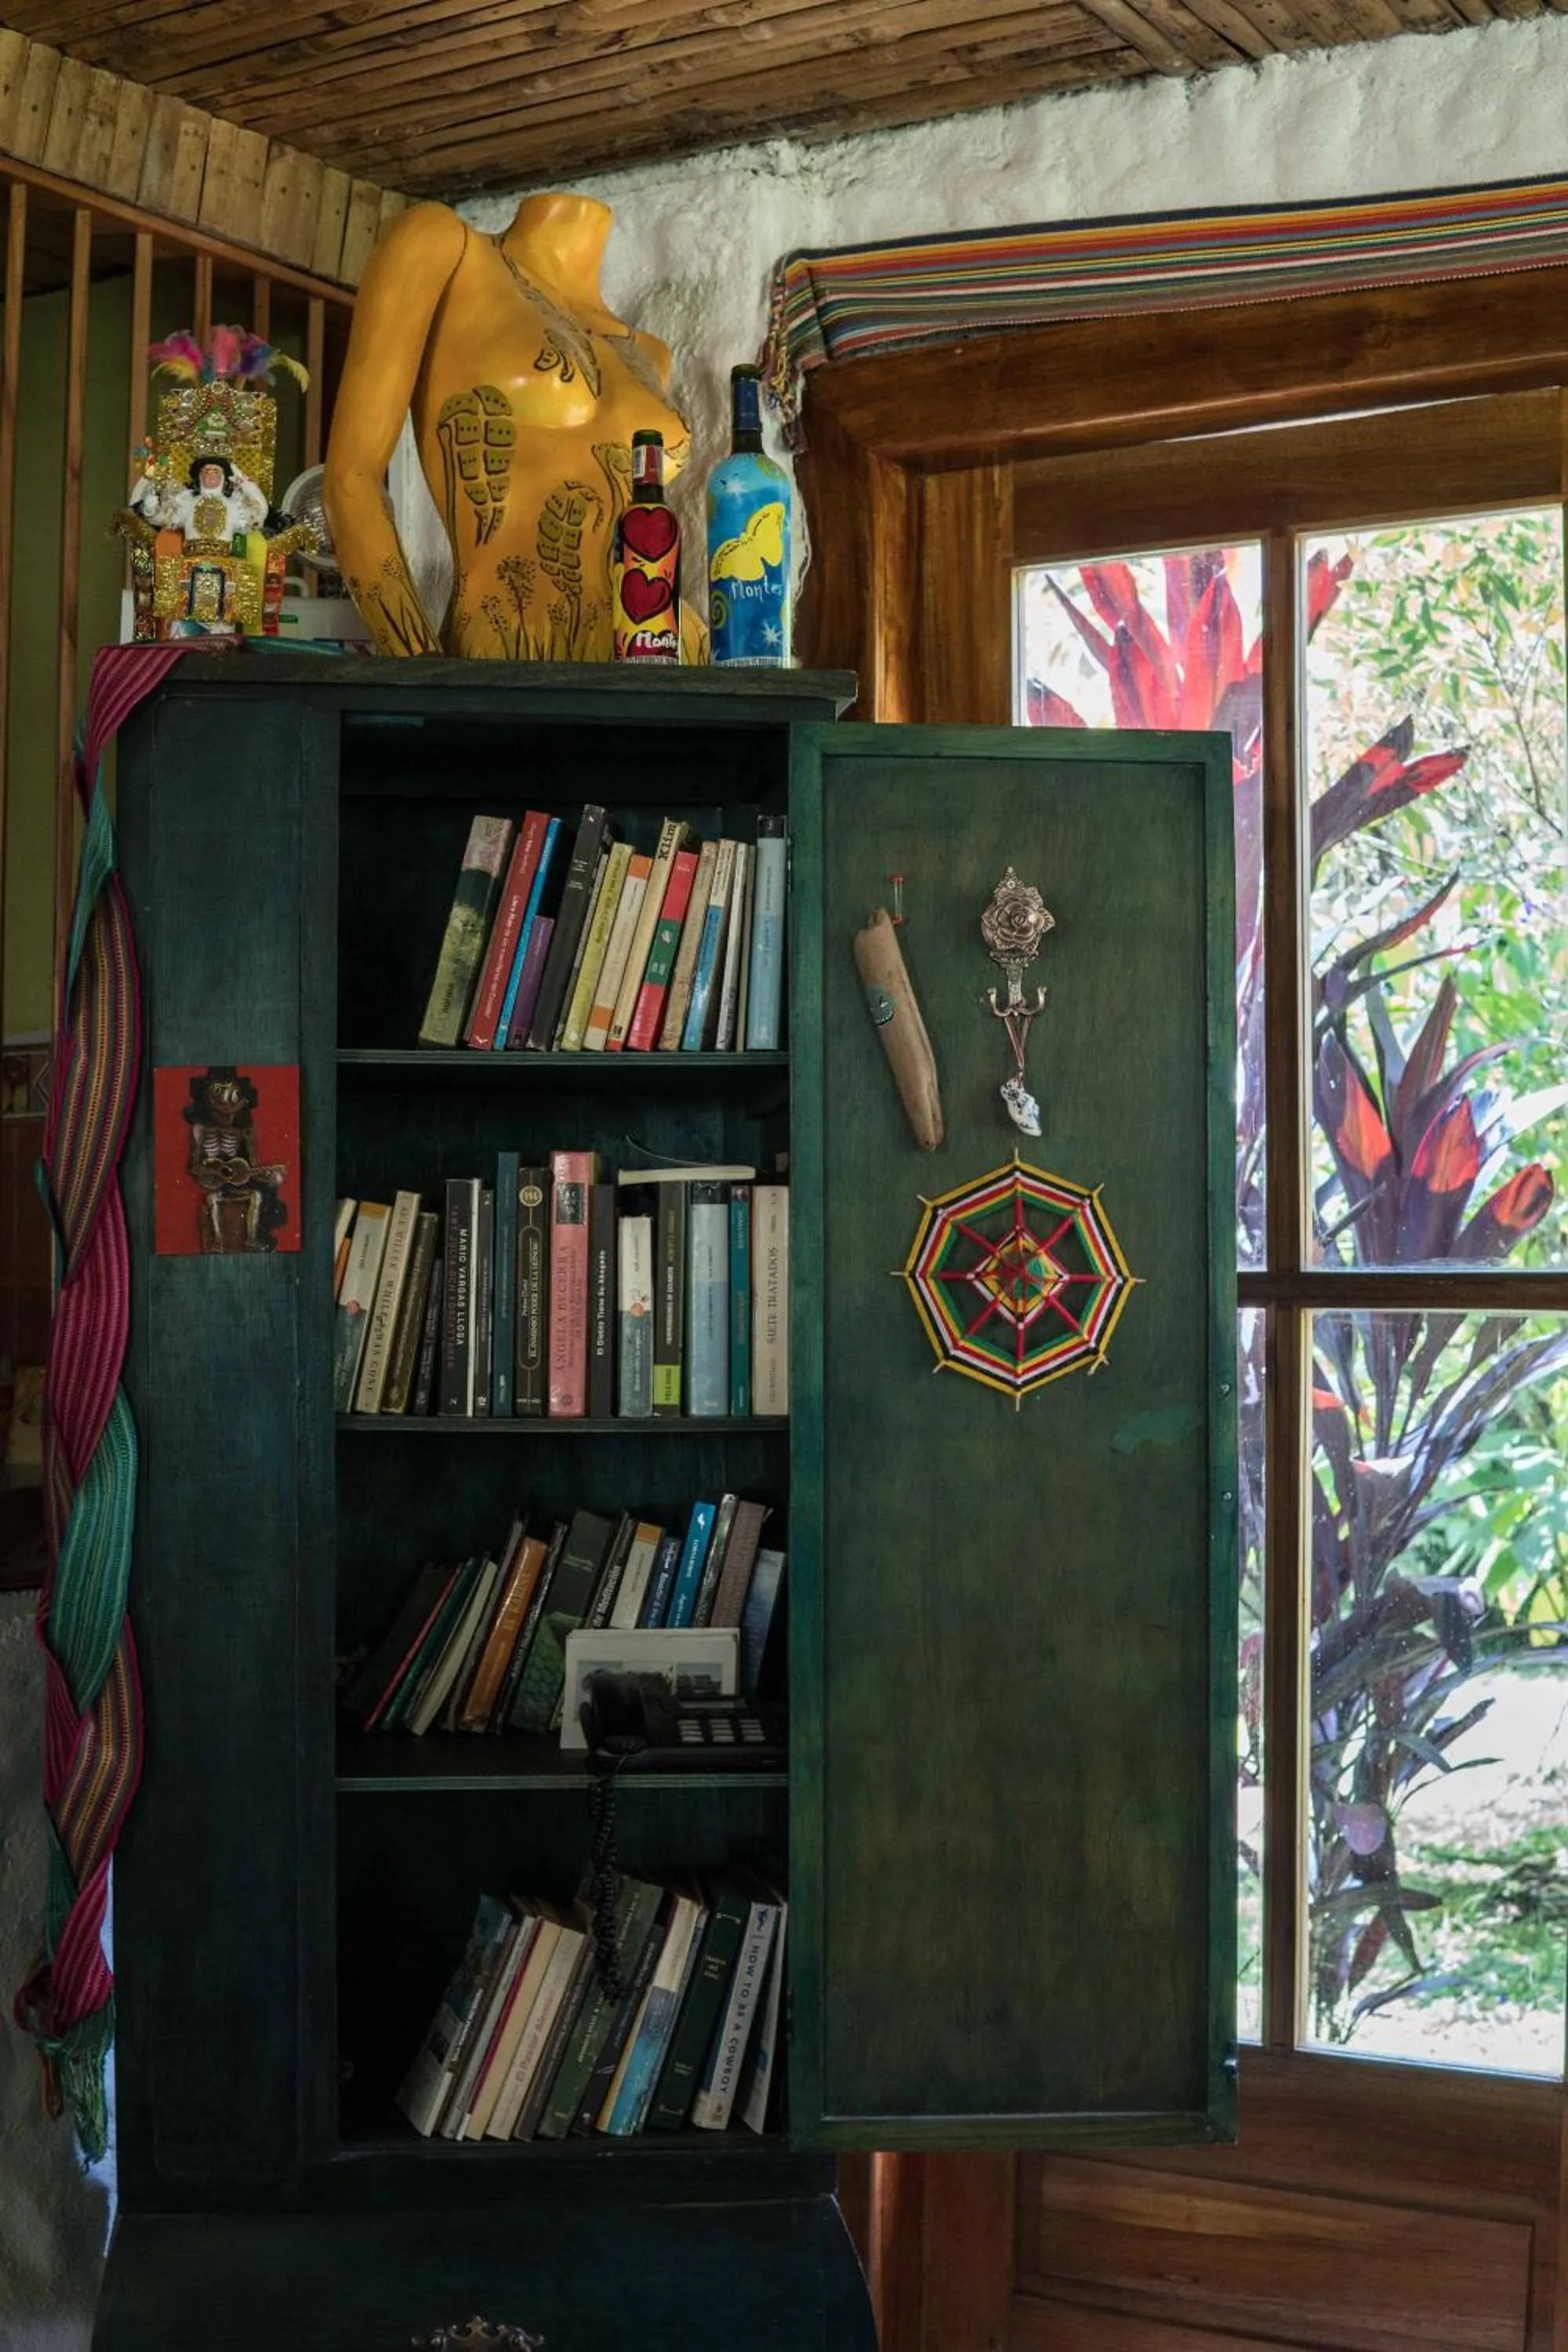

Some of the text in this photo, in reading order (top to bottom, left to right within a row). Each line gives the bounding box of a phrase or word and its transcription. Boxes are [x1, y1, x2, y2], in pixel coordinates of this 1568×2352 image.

[455, 1229, 467, 1345] MARIO VARGAS LLOSA
[555, 1246, 567, 1372] ANGELA BECERRA
[767, 1247, 779, 1343] SIETE TRATADOS
[719, 1944, 760, 2093] HOW TO BE A COWBOY
